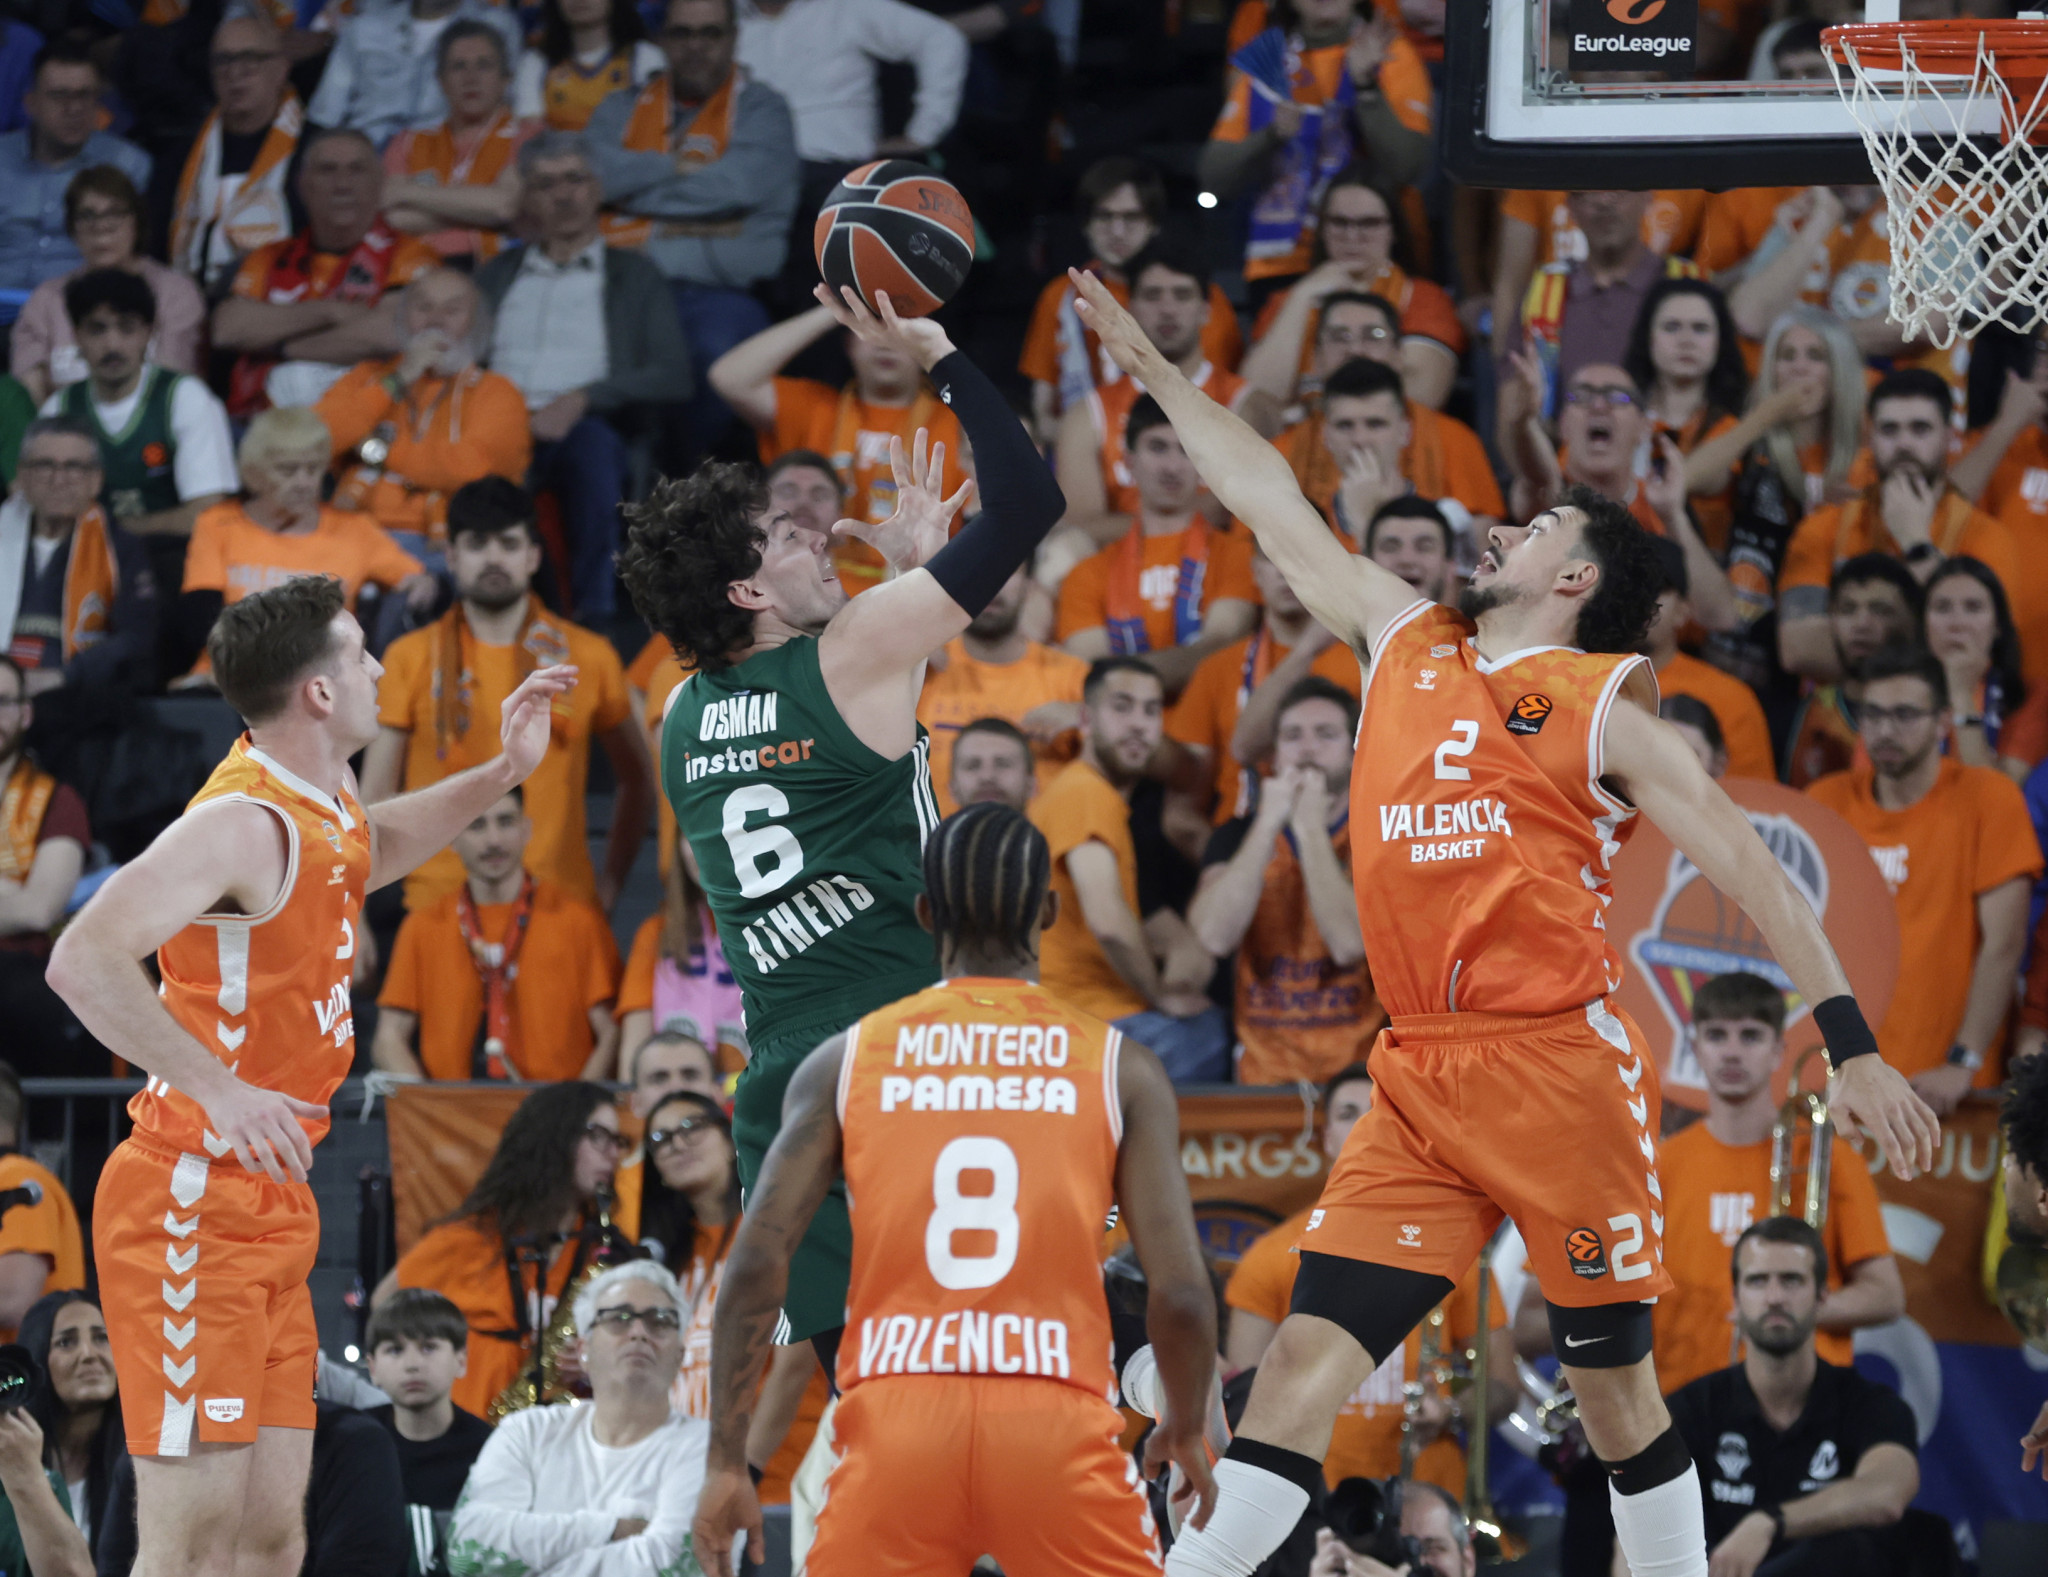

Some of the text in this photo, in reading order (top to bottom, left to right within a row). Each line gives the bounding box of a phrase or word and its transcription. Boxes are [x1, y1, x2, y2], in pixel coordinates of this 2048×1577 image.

[1574, 34, 1691, 57] EuroLeague
[699, 691, 778, 742] OSMAN
[684, 738, 815, 784] instacar
[1434, 719, 1480, 781] 2
[721, 783, 804, 899] 6
[1379, 798, 1512, 842] VALENCIA
[1410, 838, 1486, 863] BASKET
[741, 874, 875, 974] ATHENS
[894, 1022, 1069, 1068] MONTERO
[880, 1074, 1078, 1116] PAMESA
[925, 1135, 1020, 1290] 8
[1607, 1212, 1653, 1282] 2
[859, 1309, 1070, 1379] VALENCIA
